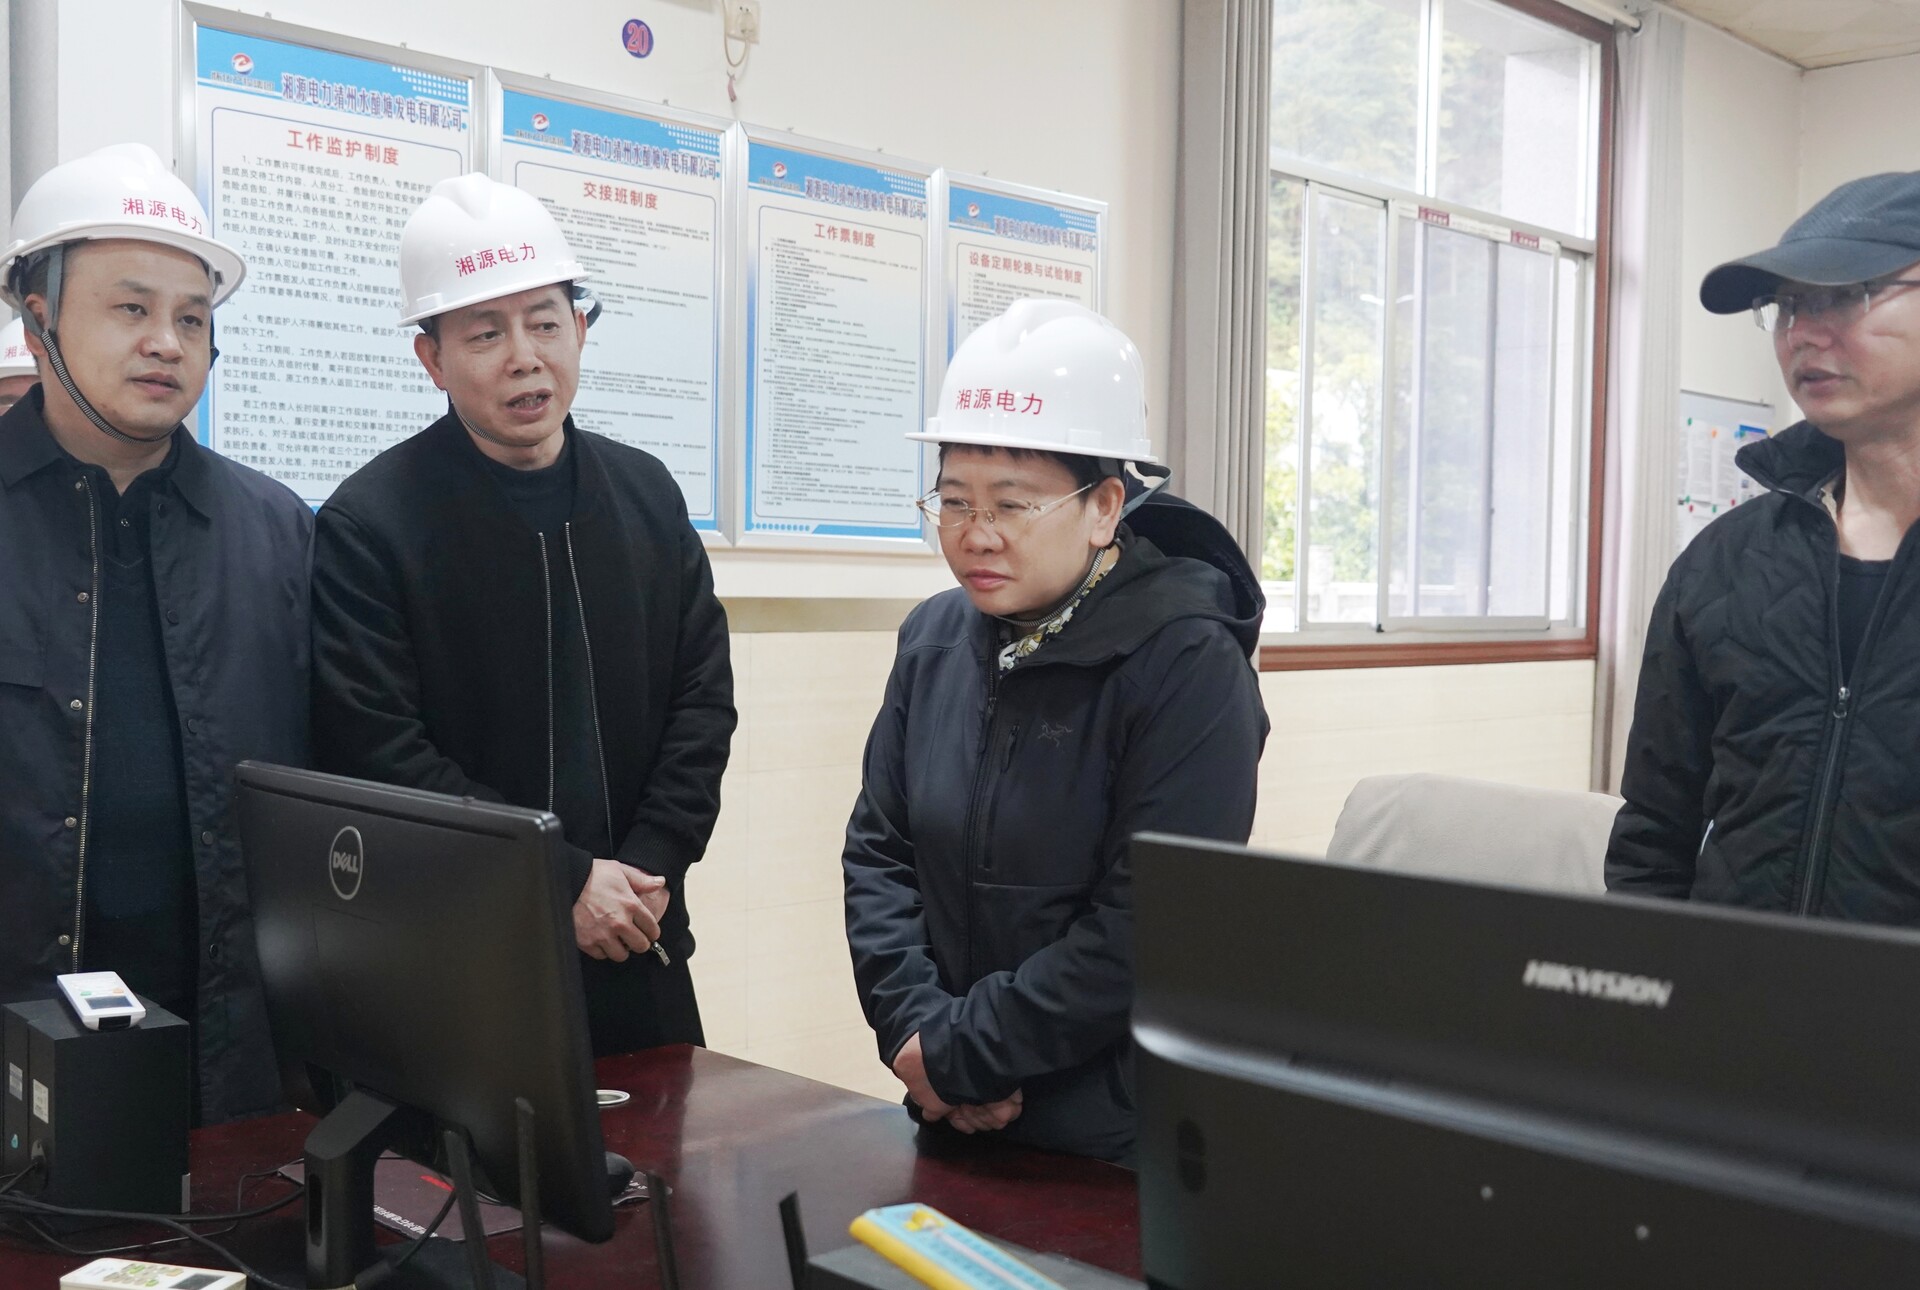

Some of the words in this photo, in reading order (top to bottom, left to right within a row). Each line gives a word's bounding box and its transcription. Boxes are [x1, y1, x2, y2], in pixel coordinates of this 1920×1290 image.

[626, 22, 649, 55] 20
[287, 129, 399, 165] 工作监护制度
[583, 181, 658, 210] 交接班制度
[123, 197, 203, 235] 湘源电力
[814, 223, 876, 248] 工作票制度
[455, 242, 536, 278] 湘源电力
[969, 251, 1083, 284] 设备定期轮换与试验制度
[955, 388, 1043, 415] 湘源电力
[332, 851, 359, 873] DELL
[1522, 959, 1673, 1009] HIKVISION
